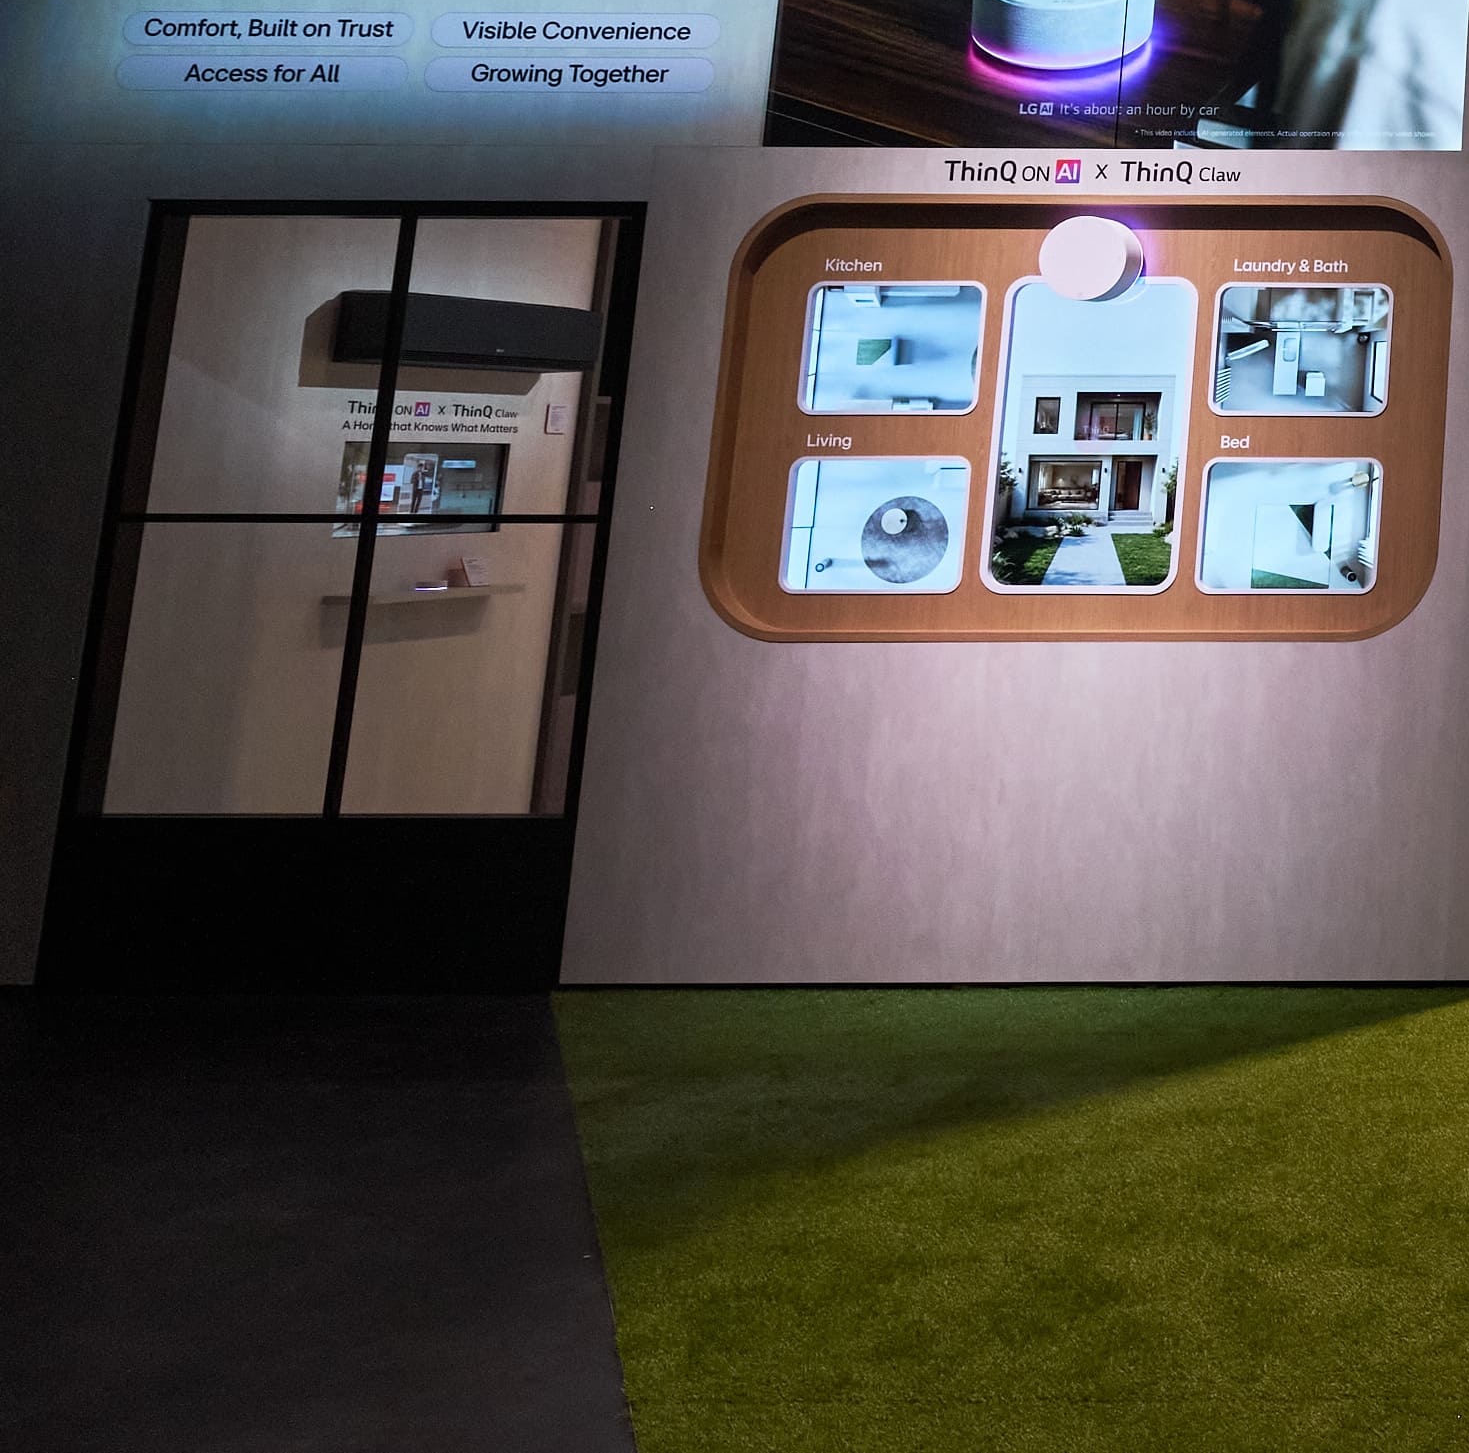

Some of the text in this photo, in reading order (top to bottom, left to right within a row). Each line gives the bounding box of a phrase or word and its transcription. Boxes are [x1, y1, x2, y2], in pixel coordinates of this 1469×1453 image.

[144, 18, 394, 39] Comfort, Built on Trust
[463, 21, 691, 40] Visible Convenience
[184, 64, 340, 82] Access for All
[471, 64, 669, 87] Growing Together
[1019, 102, 1220, 118] LG AI It's about an hour by car
[944, 160, 1018, 184] ThinQ
[1021, 166, 1050, 182] ON
[1056, 162, 1079, 181] AI
[1120, 161, 1193, 184] ThinQ
[1199, 167, 1241, 182] Claw
[825, 258, 883, 271] Kitchen
[1233, 258, 1348, 275] Laundry & Bath
[394, 404, 413, 415] ON
[415, 403, 430, 416] AI
[452, 404, 493, 419] ThinQ
[495, 409, 518, 418] Claw
[342, 420, 351, 430] A
[390, 421, 411, 431] that
[413, 422, 449, 433] Knows
[451, 423, 479, 433] What
[479, 423, 519, 434] Matters
[807, 434, 852, 450] Living
[1220, 435, 1250, 449] Bed
